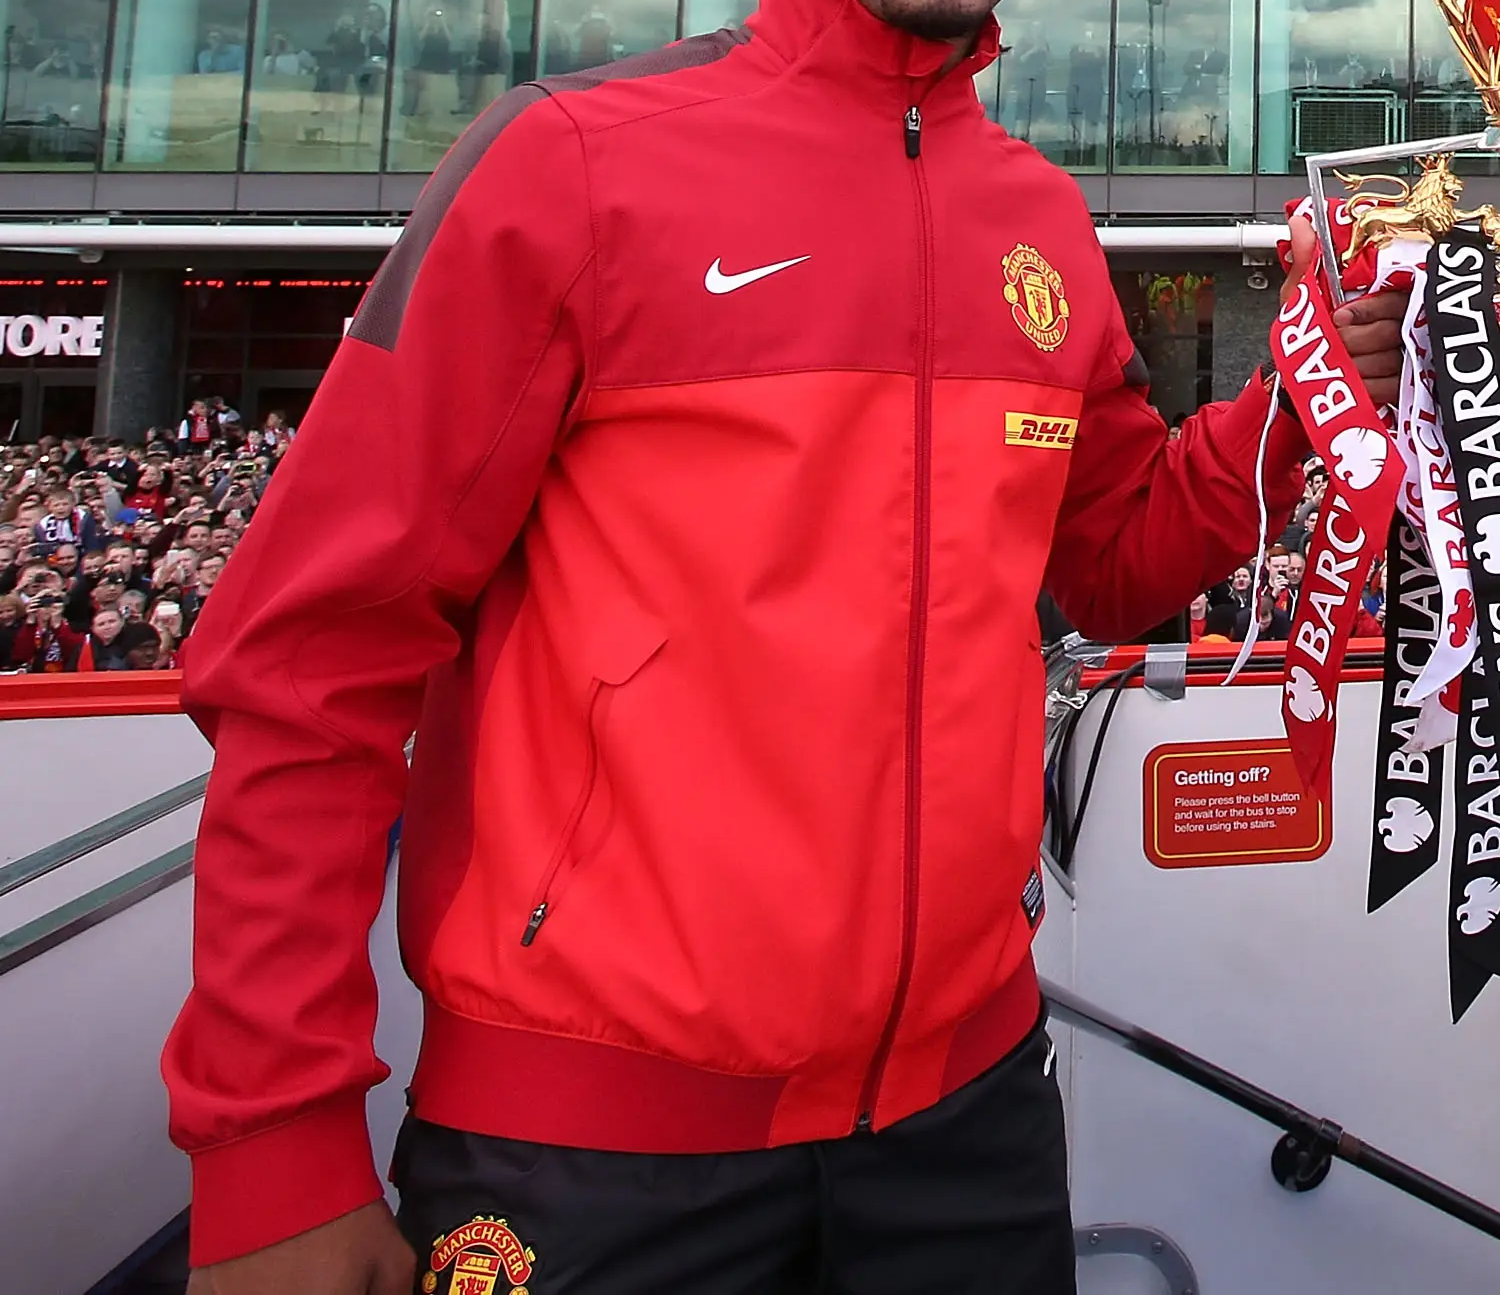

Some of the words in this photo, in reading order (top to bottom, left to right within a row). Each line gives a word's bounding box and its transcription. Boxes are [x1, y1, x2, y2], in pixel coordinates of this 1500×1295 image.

[1009, 251, 1062, 292] MANCHESTER
[1025, 323, 1061, 344] UNITED
[1019, 419, 1071, 444] DHL
[1174, 769, 1235, 787] Getting
[1238, 766, 1270, 782] off?
[1174, 796, 1206, 807] Please
[1208, 796, 1234, 808] press
[1236, 794, 1250, 804] the
[1252, 793, 1269, 803] bell
[1271, 792, 1300, 802] button
[1174, 810, 1192, 820] and
[1194, 809, 1214, 819] wait
[1215, 808, 1228, 818] for
[1230, 807, 1244, 817] the
[1246, 806, 1263, 816] bus
[1265, 806, 1275, 815] to
[1277, 805, 1297, 817] stop
[1174, 822, 1204, 833] before
[1206, 821, 1231, 833] using
[1233, 820, 1248, 830] the
[1250, 819, 1277, 829] stairs.
[438, 1225, 524, 1276] MANCHESTER
